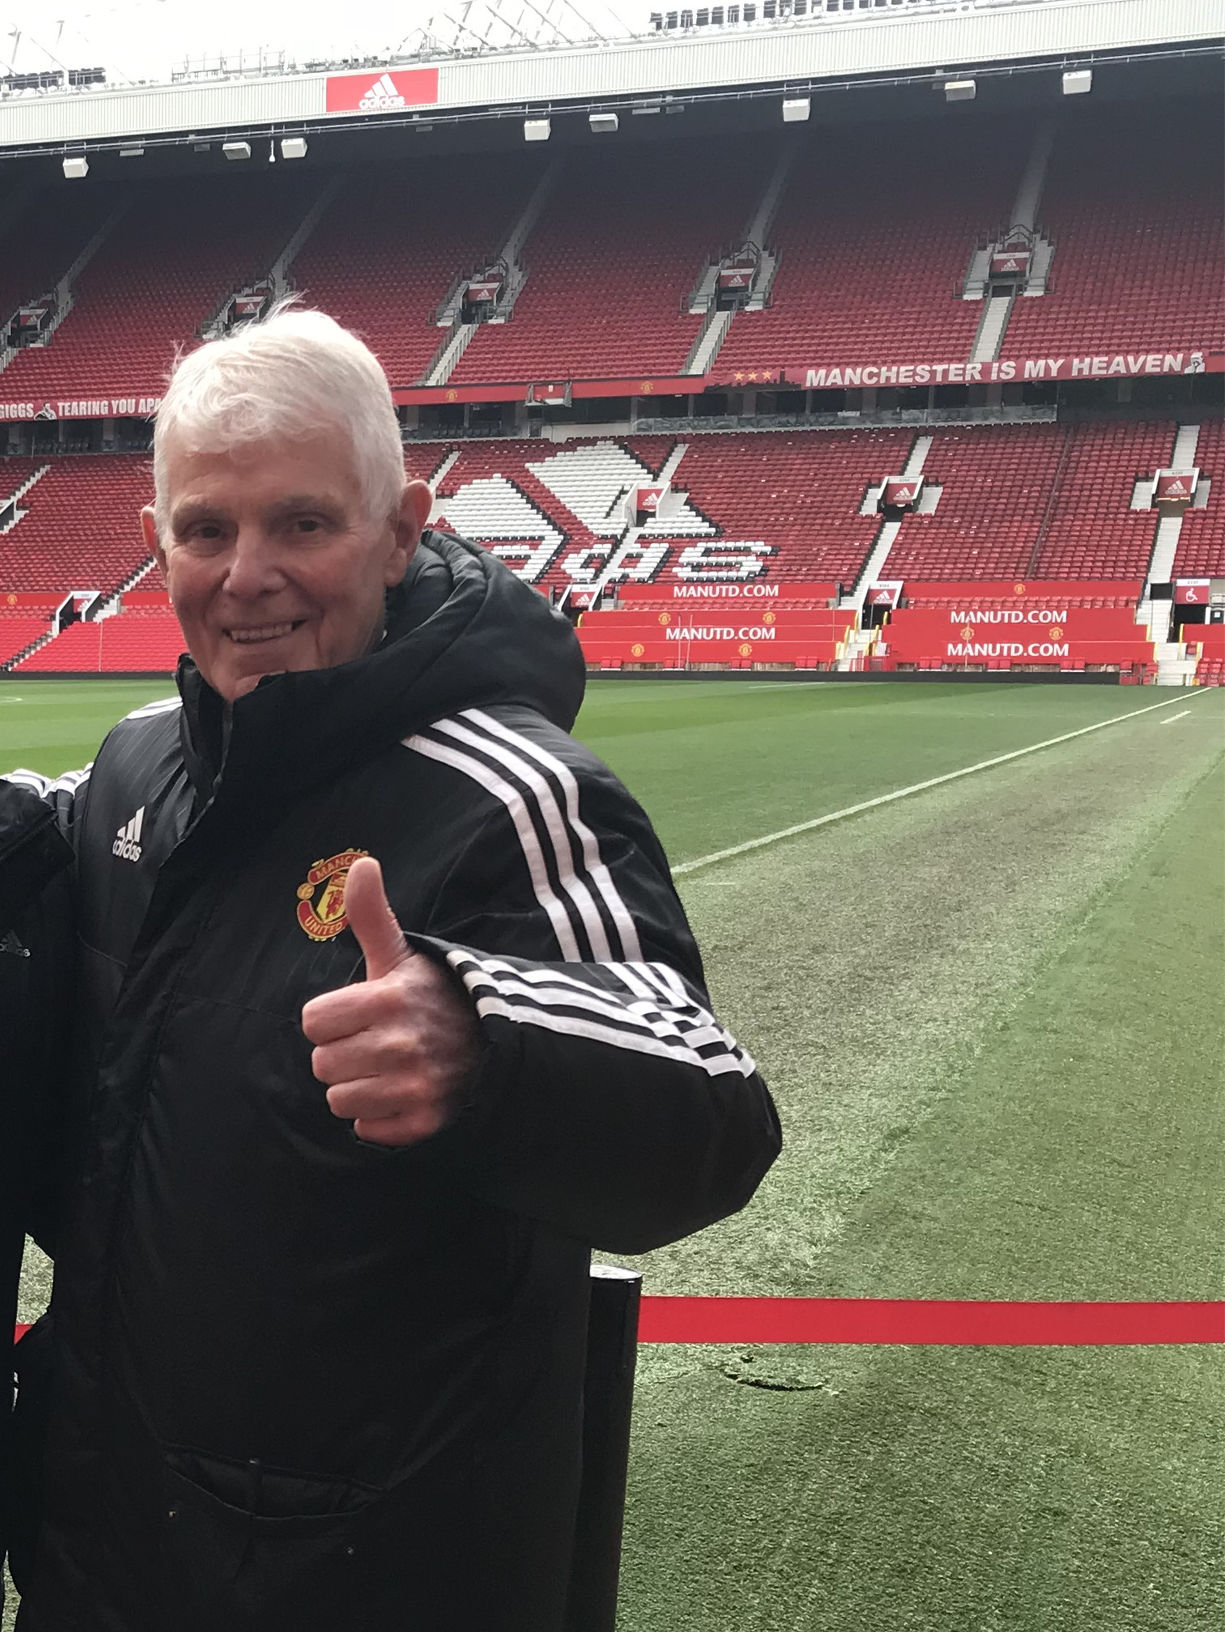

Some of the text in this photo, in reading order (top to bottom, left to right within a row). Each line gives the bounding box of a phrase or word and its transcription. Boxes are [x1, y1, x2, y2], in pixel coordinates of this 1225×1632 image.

[805, 353, 1184, 387] MANCHESTER IS MY HEAVEN
[57, 401, 109, 416] TEARING
[111, 399, 136, 415] YOU
[673, 585, 779, 598] MANUTD.COM
[950, 610, 1067, 623] MANUTD.COM
[665, 627, 776, 641] MANUTD.COM
[947, 642, 1069, 656] MANUTD.COM
[112, 836, 143, 862] adidas
[304, 915, 343, 935] UNITED
